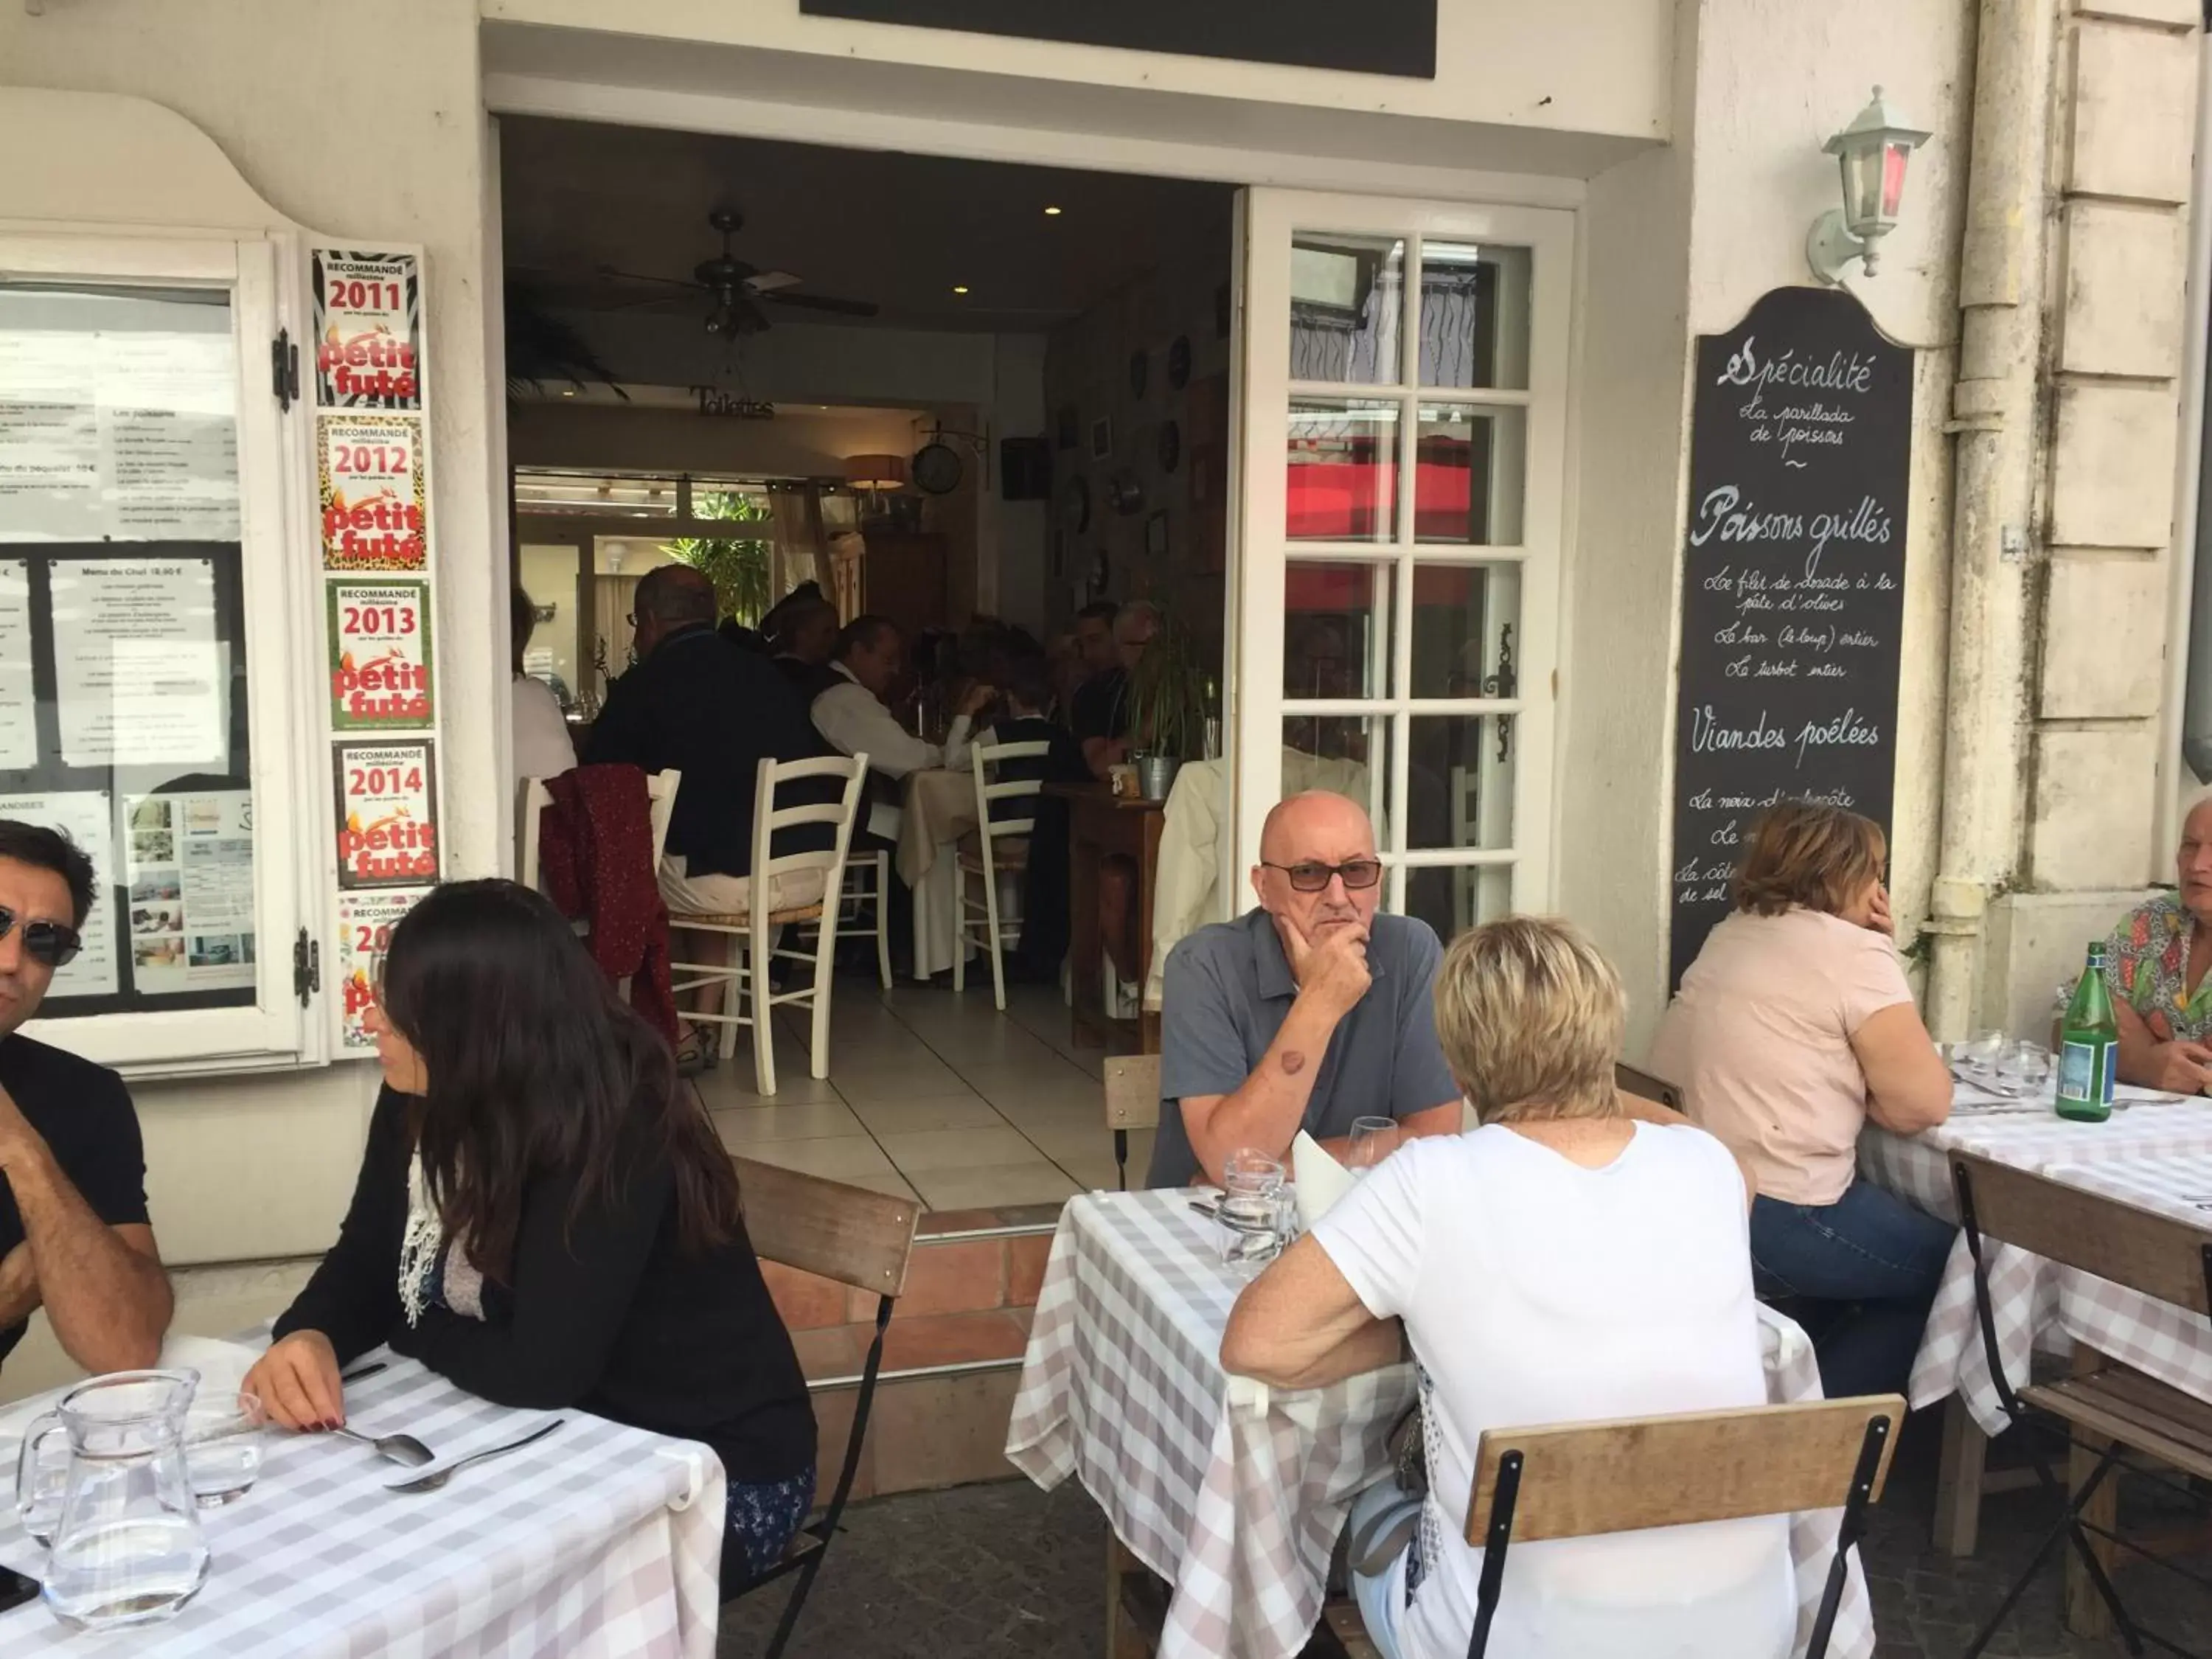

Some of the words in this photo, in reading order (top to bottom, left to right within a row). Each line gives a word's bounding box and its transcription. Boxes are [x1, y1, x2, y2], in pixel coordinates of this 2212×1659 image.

[327, 262, 403, 274] RECOMMANDÉ
[330, 279, 399, 310] 2011
[319, 339, 415, 372] petit
[1717, 335, 1877, 398] Spécialité
[335, 366, 417, 398] futé
[1739, 396, 1768, 420] La
[331, 428, 408, 437] RECOMMANDÉ
[1750, 424, 1772, 442] de
[335, 445, 408, 473] 2012
[324, 501, 421, 538] petit
[1689, 484, 1804, 546] Poissons
[1806, 495, 1891, 579] grillés
[341, 529, 423, 559] futé
[341, 589, 417, 599] RECOMMANDÉ
[1738, 569, 1767, 598] filet
[1770, 574, 1791, 591] de
[1856, 572, 1870, 590] à
[1874, 572, 1898, 590] la
[344, 607, 416, 634] 2013
[1737, 626, 1768, 644] bar
[333, 662, 430, 698] petit
[1754, 659, 1799, 678] turbot
[1807, 662, 1847, 678] entier
[349, 690, 431, 720] futé
[1692, 704, 1786, 752] Viandes
[1795, 707, 1879, 770] poêlées
[346, 750, 422, 760] RECOMMANDÉ
[349, 767, 422, 796] 2014
[1688, 787, 1711, 810] La
[1719, 792, 1756, 809] noix
[339, 821, 435, 859] petit
[1711, 819, 1739, 844] Le
[356, 851, 436, 878] futé
[1675, 857, 1700, 883] La
[1679, 887, 1698, 903] de
[1701, 883, 1727, 902] sel
[353, 908, 411, 918] RECOMMA
[356, 925, 392, 951] 20
